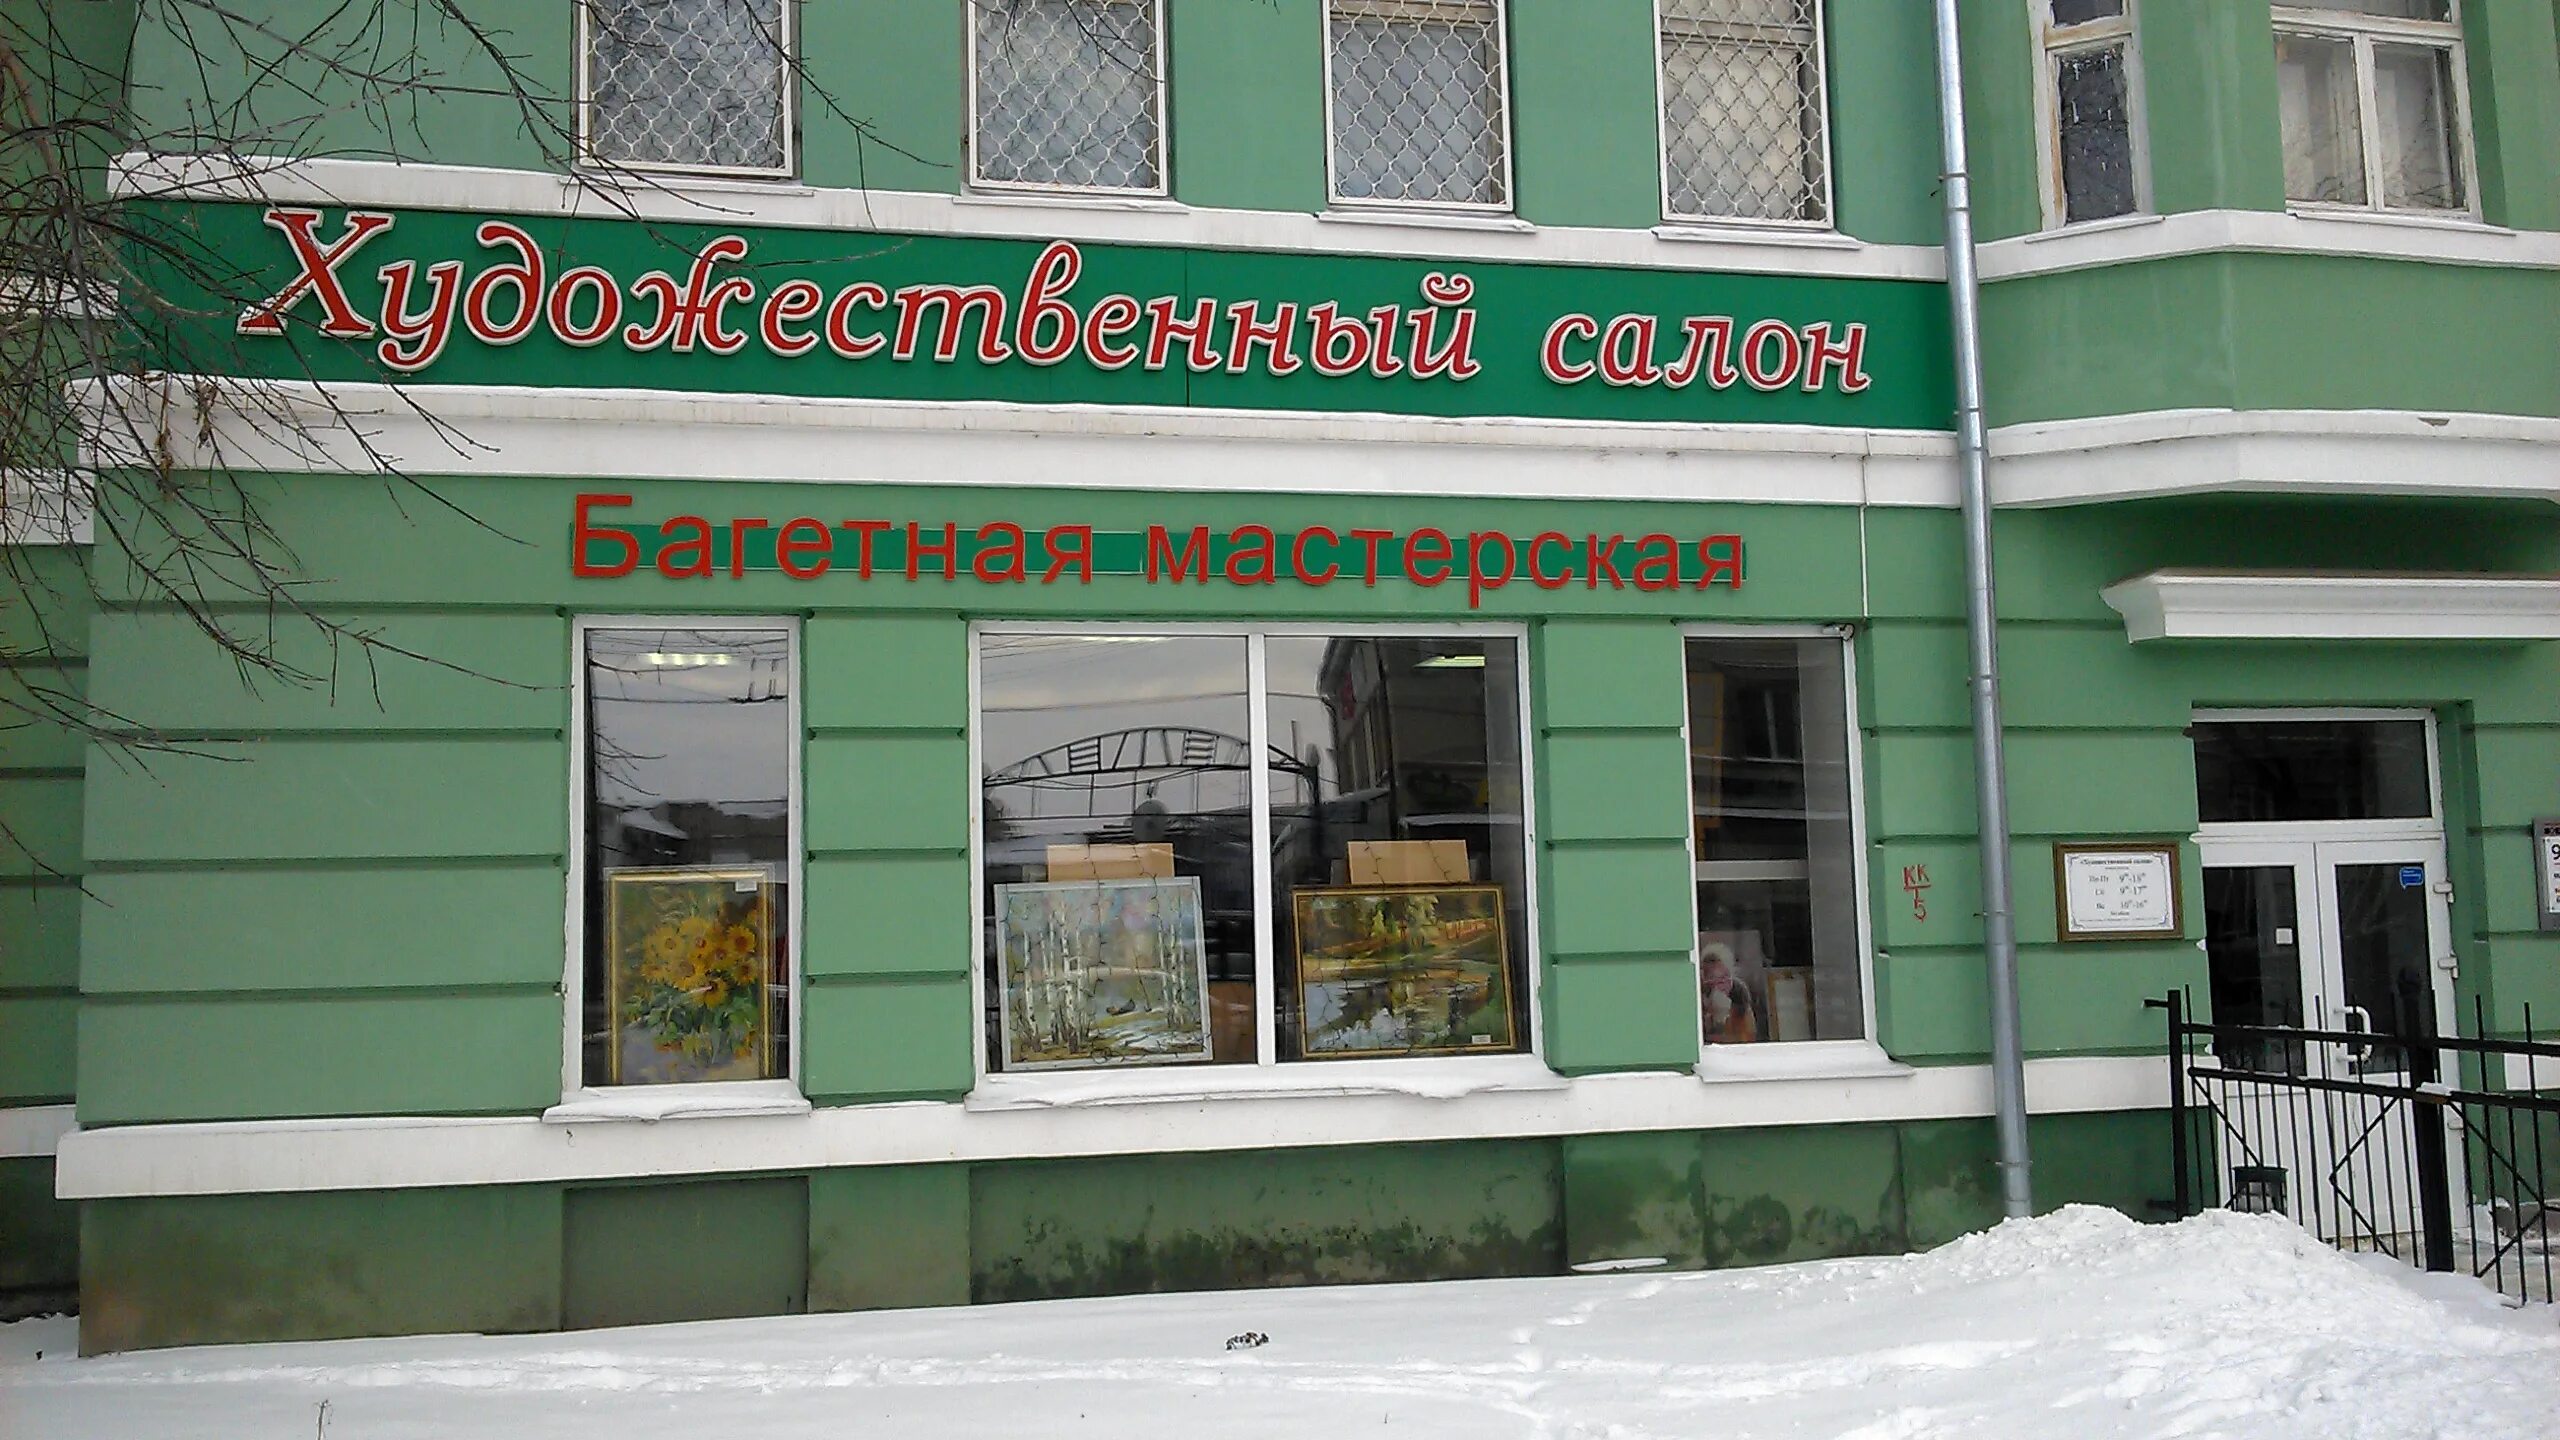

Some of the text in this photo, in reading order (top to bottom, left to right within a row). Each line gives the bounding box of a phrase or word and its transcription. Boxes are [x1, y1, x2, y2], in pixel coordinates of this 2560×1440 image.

[236, 209, 1873, 393] Художественный салон
[572, 493, 1744, 609] Багетная мастерская
